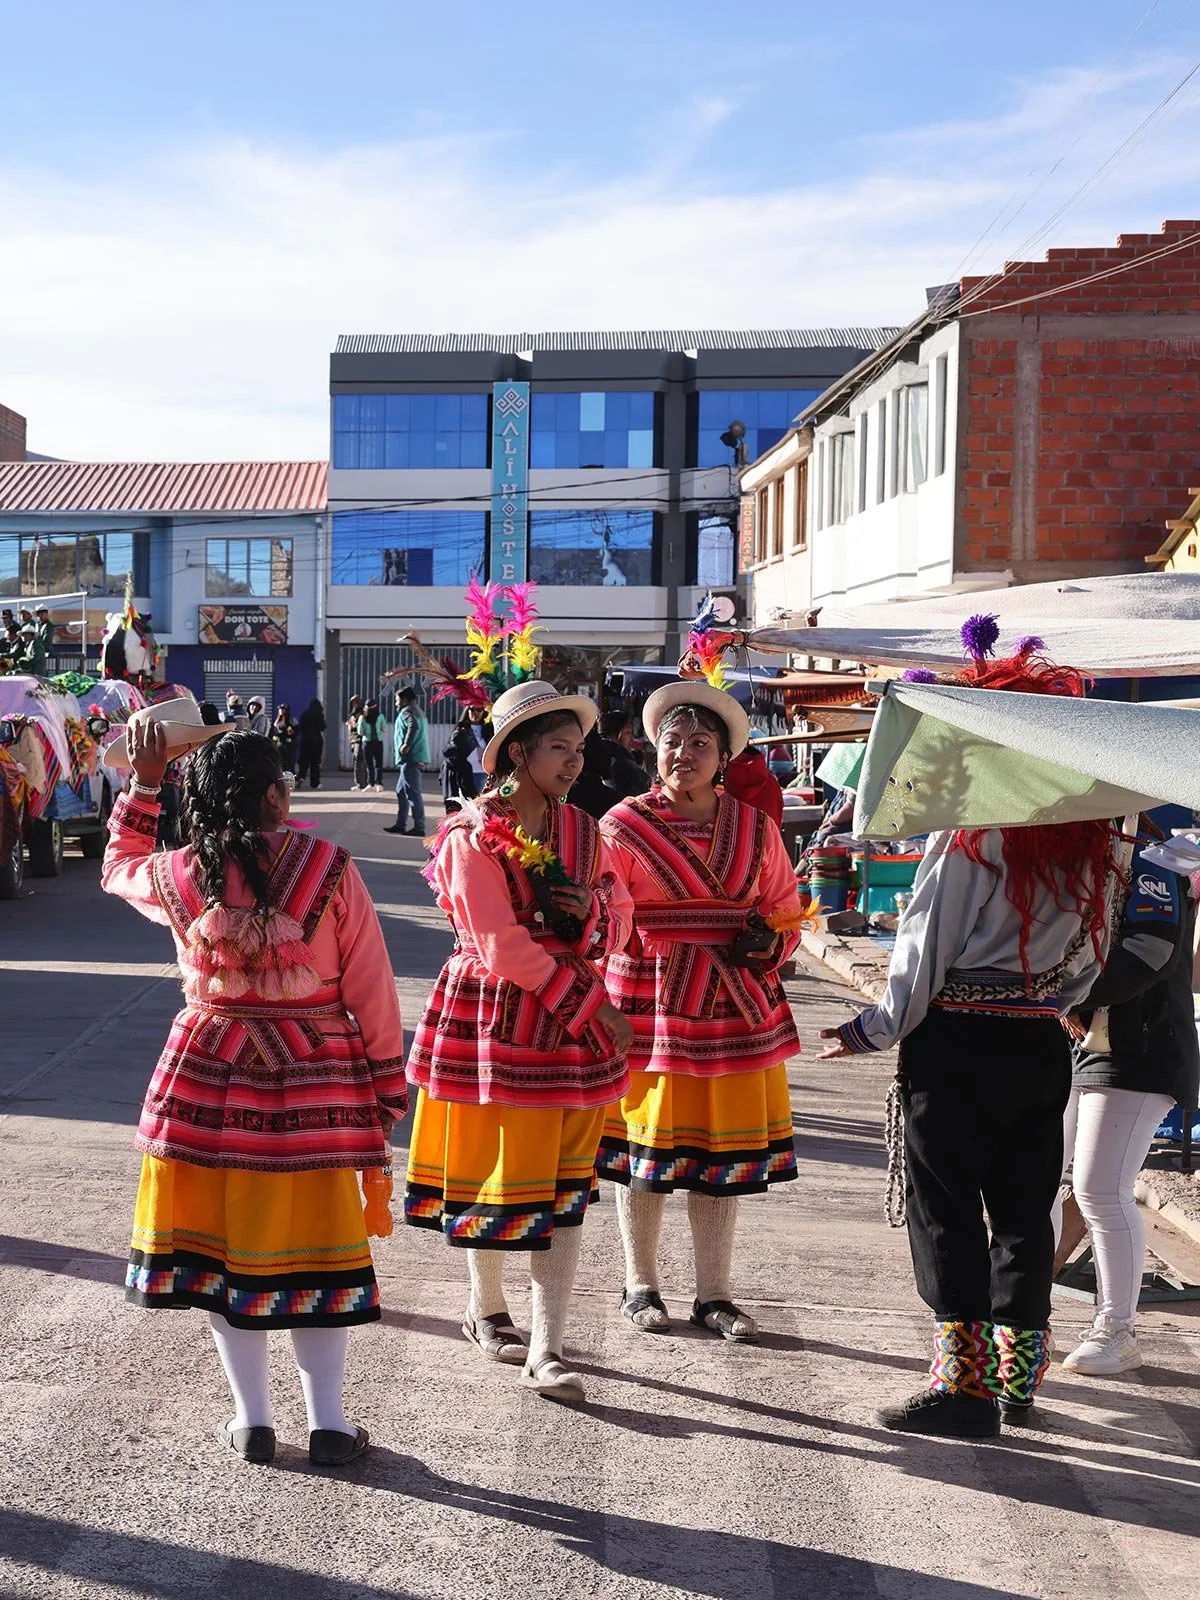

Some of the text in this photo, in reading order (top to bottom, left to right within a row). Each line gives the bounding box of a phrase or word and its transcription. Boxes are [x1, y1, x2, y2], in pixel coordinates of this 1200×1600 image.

[501, 483, 518, 602] HOSTE
[224, 615, 269, 624] DON TOTE
